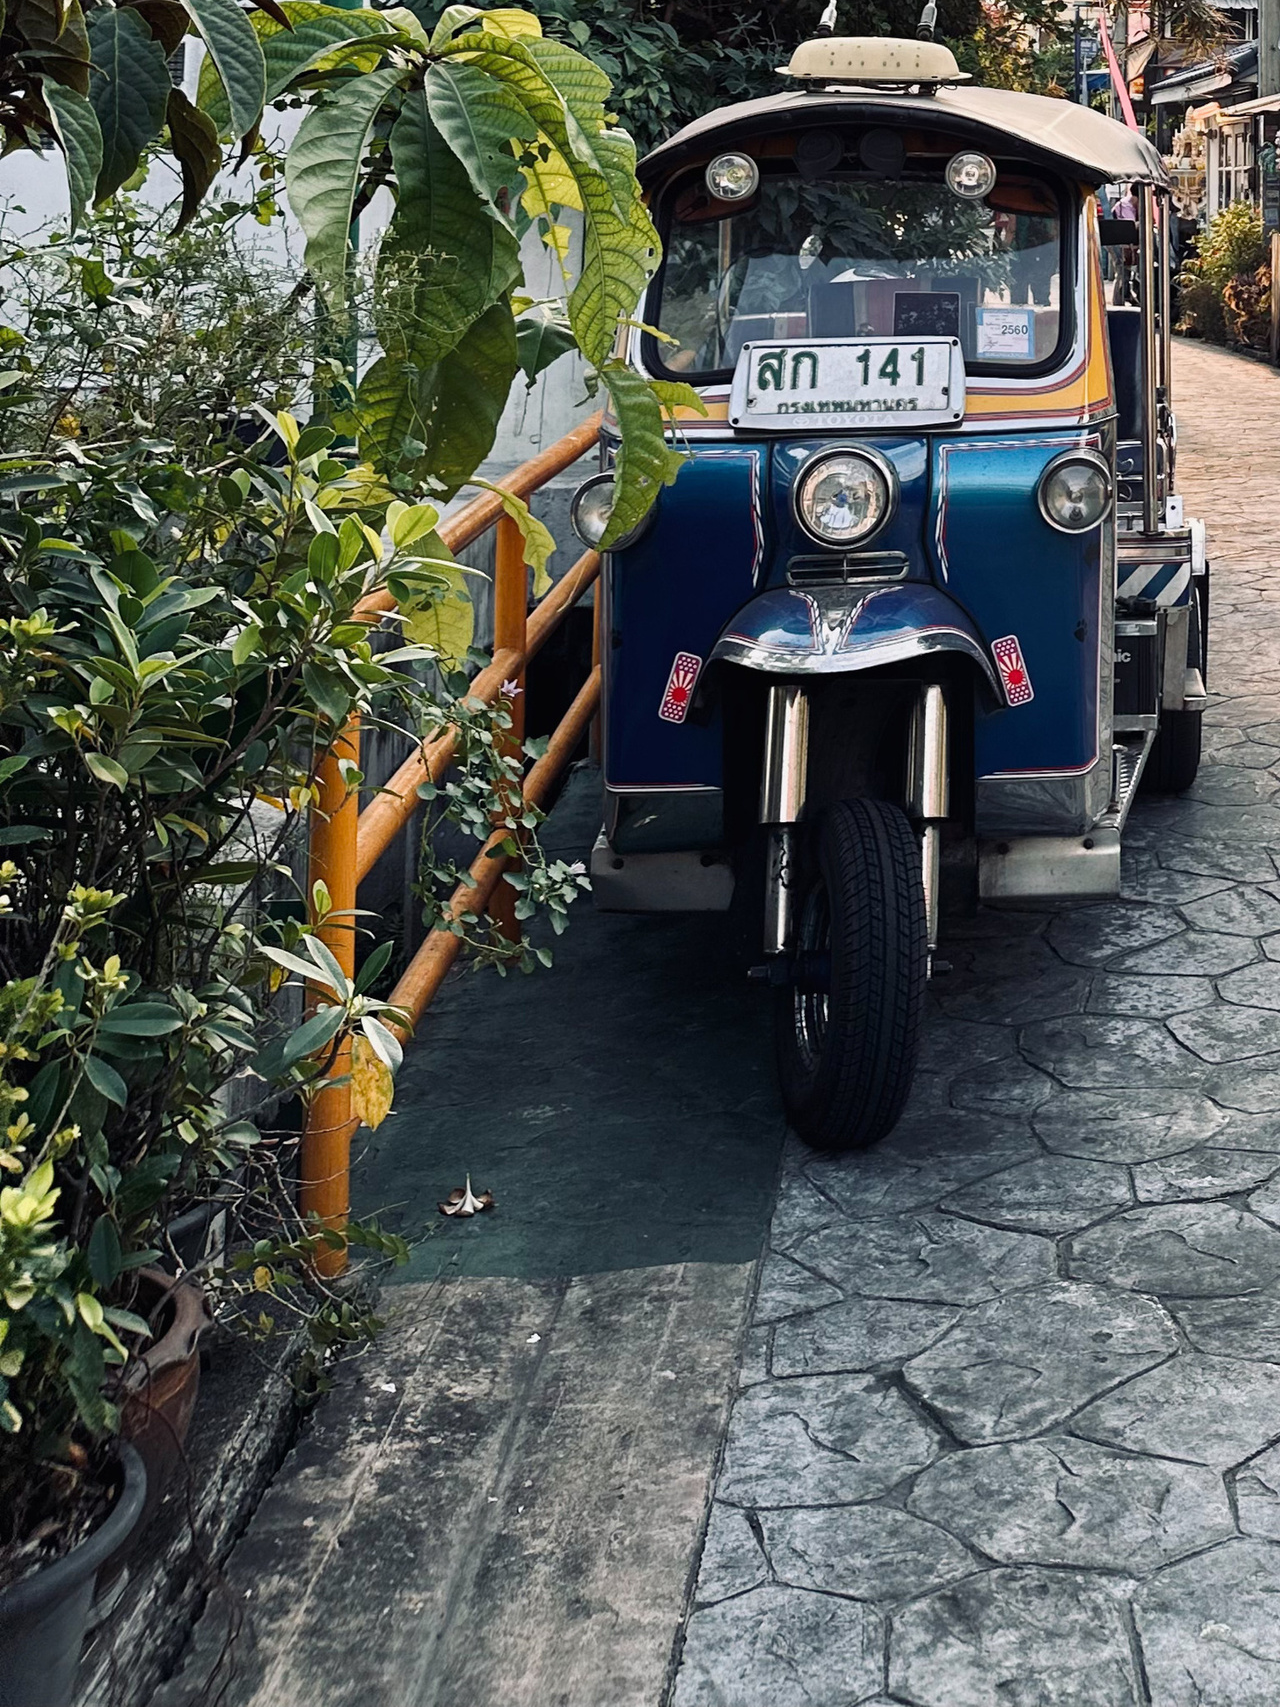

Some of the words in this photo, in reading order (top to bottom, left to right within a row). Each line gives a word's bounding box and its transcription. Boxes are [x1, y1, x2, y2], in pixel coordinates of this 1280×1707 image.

[1001, 324, 1029, 335] 2560
[757, 348, 819, 392] สก
[856, 346, 926, 387] 141
[814, 414, 897, 426] TOYOTA
